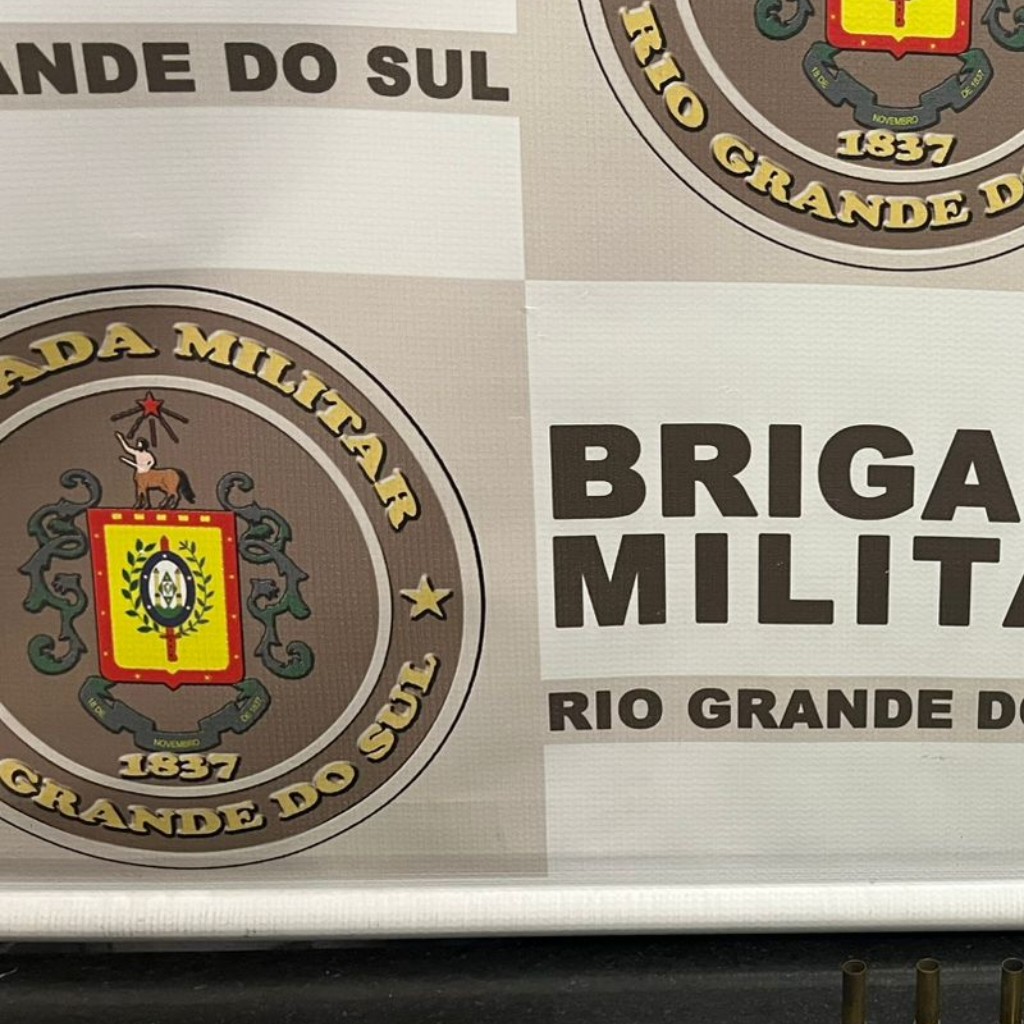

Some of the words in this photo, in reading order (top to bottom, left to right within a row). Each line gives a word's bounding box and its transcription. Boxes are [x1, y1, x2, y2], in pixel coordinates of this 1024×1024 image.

[224, 42, 336, 93] DO
[367, 46, 509, 101] SUL
[960, 87, 974, 99] DE
[619, 1, 708, 131] RIO
[710, 132, 972, 231] GRANDE
[872, 113, 920, 127] NOVEMBRO
[837, 129, 957, 166] 1837
[172, 321, 422, 531] MILITAR
[549, 689, 662, 731] RIO
[688, 688, 953, 729] GRANDE
[0, 757, 266, 837] GRANDE
[271, 761, 358, 820] DO
[358, 652, 439, 762] SUL
[118, 751, 242, 782] 1837
